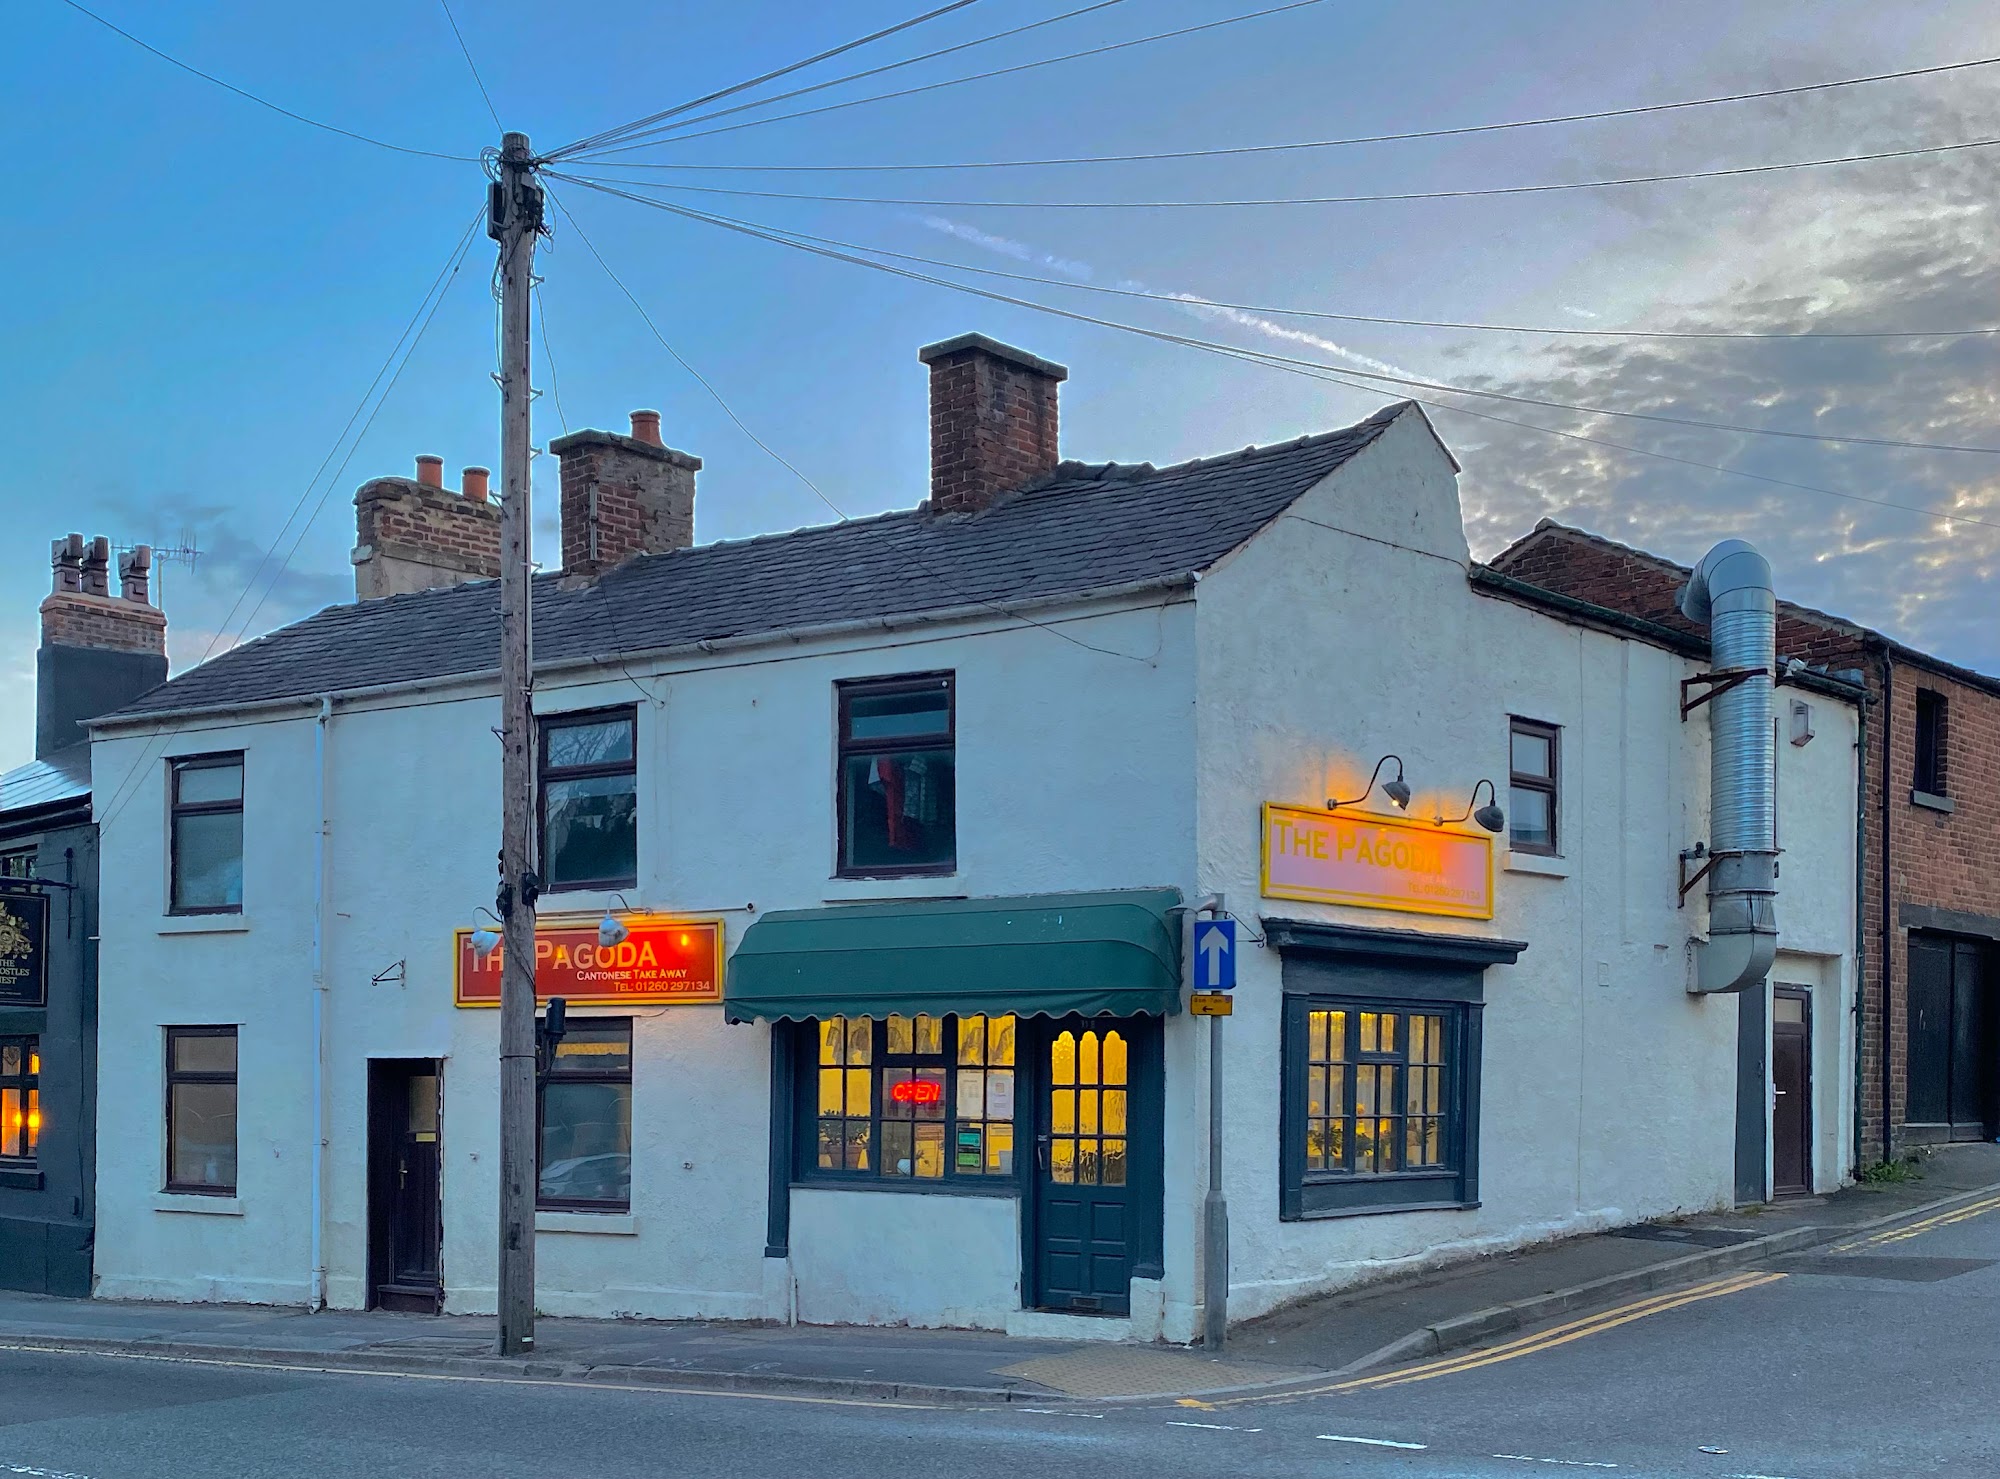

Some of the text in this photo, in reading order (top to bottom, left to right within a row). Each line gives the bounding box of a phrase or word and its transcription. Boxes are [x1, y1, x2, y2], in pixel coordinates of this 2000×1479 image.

[1273, 818, 1443, 875] THE PAGODA
[466, 939, 659, 973] TH PAGODA
[0, 967, 30, 977] OSTLES
[576, 968, 688, 981] CANTONESE TAKE AWAY
[635, 981, 669, 991] 01260
[670, 980, 711, 991] 297134
